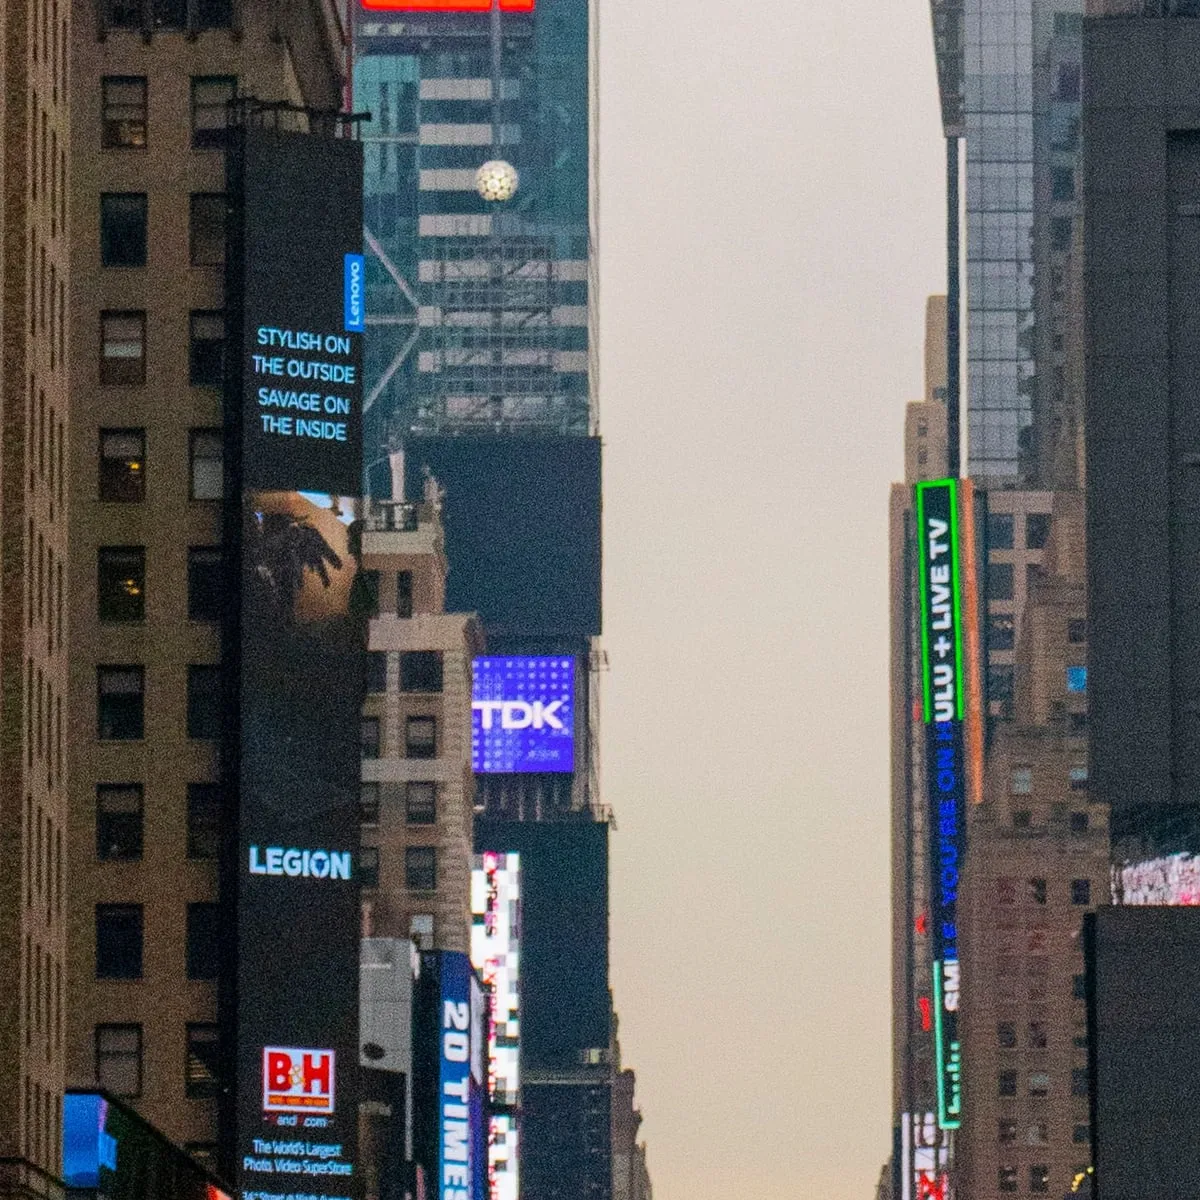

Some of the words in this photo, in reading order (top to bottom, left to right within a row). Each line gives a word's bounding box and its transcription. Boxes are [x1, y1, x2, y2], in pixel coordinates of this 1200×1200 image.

[349, 261, 360, 326] Lenovo
[257, 327, 322, 351] STYLISH
[324, 335, 350, 354] ON
[252, 355, 285, 376] THE
[287, 360, 355, 384] OUTSIDE
[258, 387, 321, 412] SAVAGE
[323, 396, 350, 414] ON
[261, 415, 293, 435] THE
[296, 419, 347, 441] INSIDE
[928, 518, 950, 560] TV
[931, 566, 952, 630] LIVE
[471, 701, 564, 729] TDK
[248, 846, 352, 880] LEGION
[443, 1000, 469, 1062] 20
[268, 1051, 330, 1094] B&H
[252, 1139, 271, 1153] The
[306, 1142, 342, 1158] Largest
[275, 1158, 302, 1173] Video
